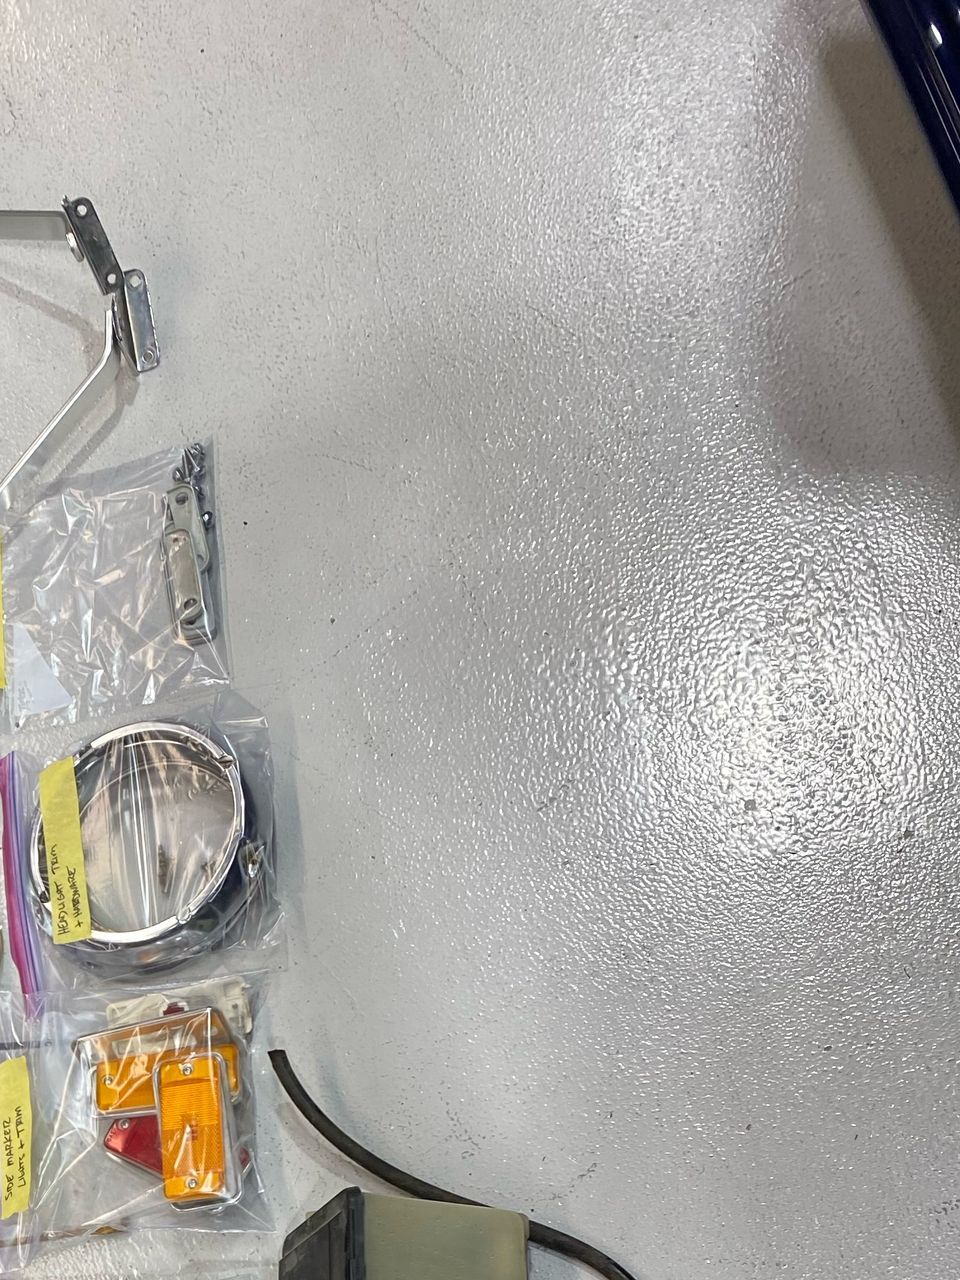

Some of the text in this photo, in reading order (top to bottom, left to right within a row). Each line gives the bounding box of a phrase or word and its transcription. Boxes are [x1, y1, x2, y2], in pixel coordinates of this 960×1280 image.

[50, 843, 60, 875] TRIM
[15, 1105, 25, 1139] TRIM
[3, 1117, 15, 1201] SIDE MARKER
